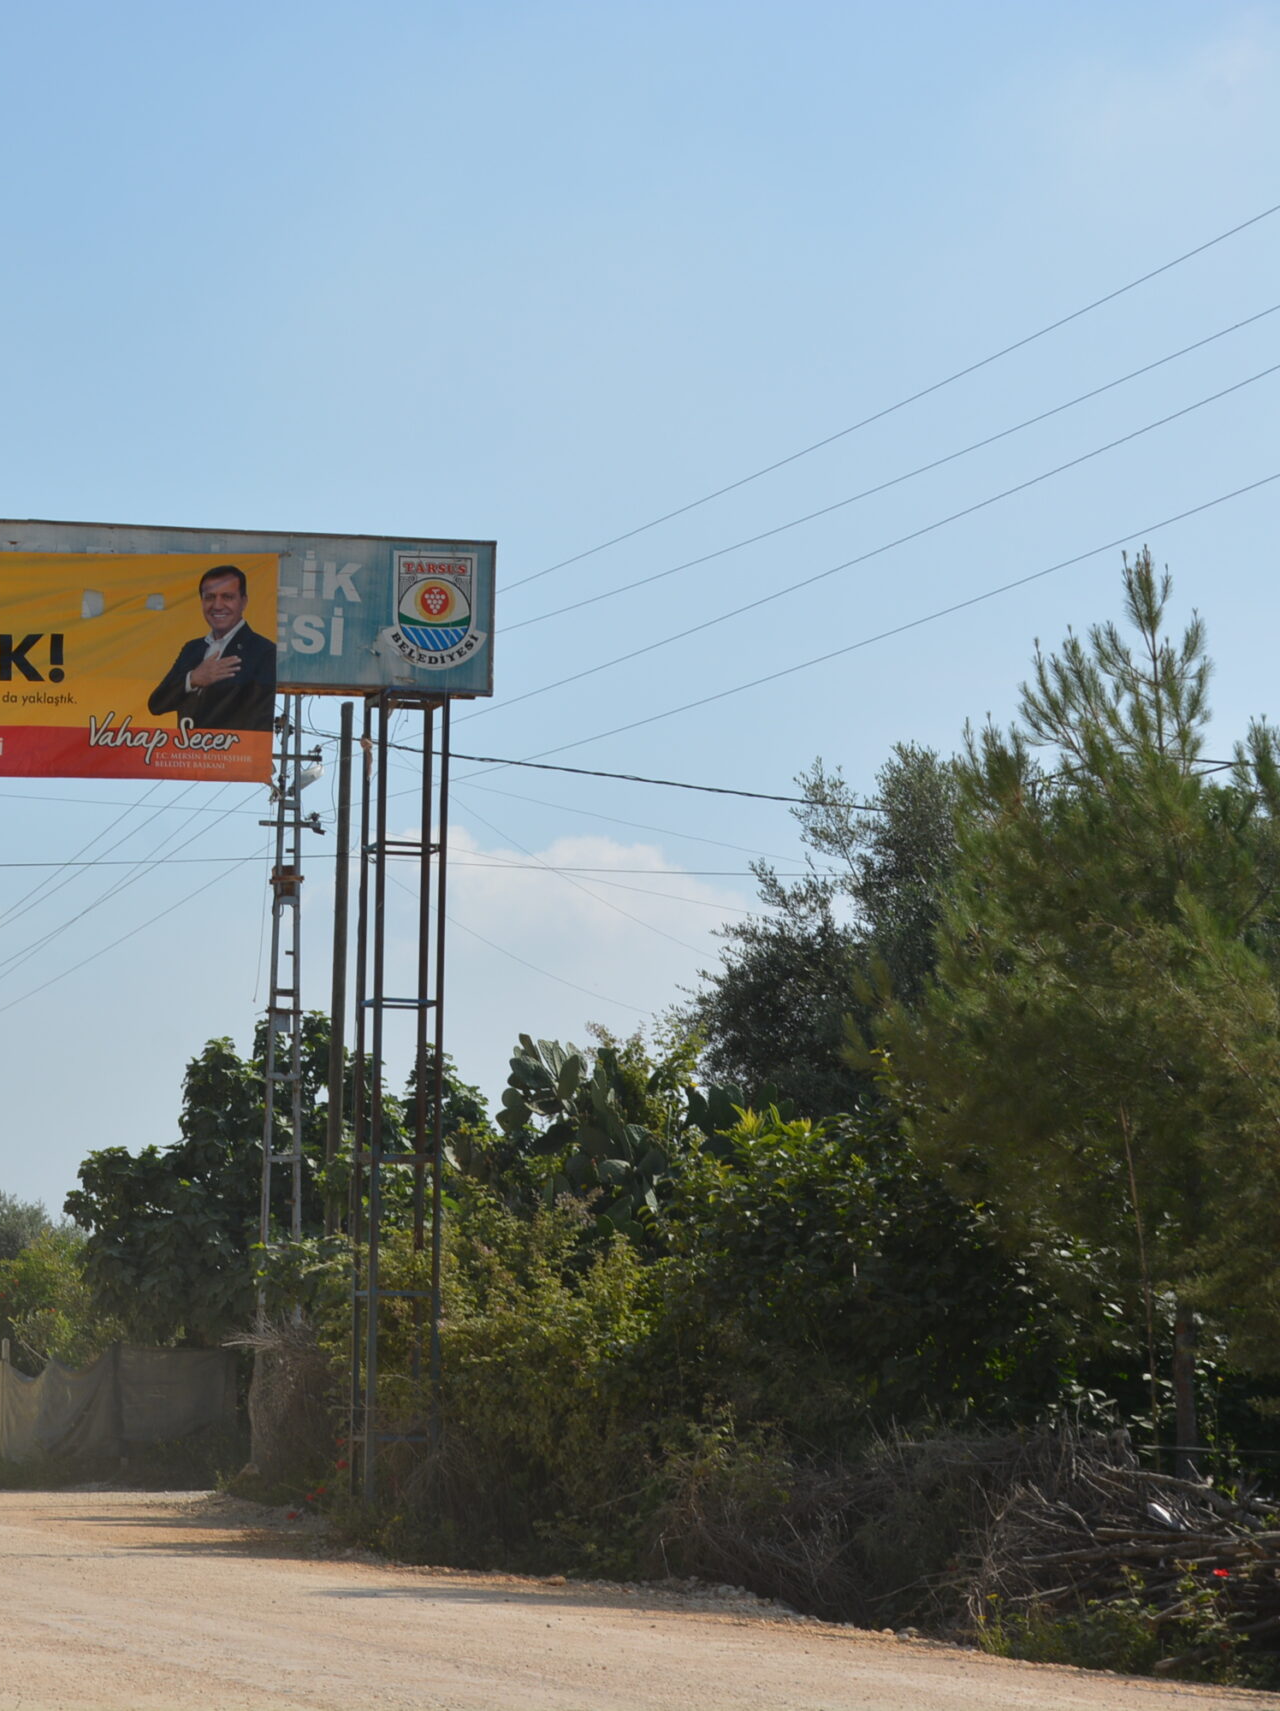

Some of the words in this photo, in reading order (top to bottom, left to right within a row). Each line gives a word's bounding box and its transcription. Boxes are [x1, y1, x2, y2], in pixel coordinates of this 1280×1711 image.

[403, 562, 468, 574] TARSUS
[391, 632, 480, 666] BELEDİYESİ
[2, 691, 18, 703] da
[22, 693, 77, 706] yaklaştık.
[89, 711, 169, 764] Vahap
[174, 716, 241, 751] Seçer
